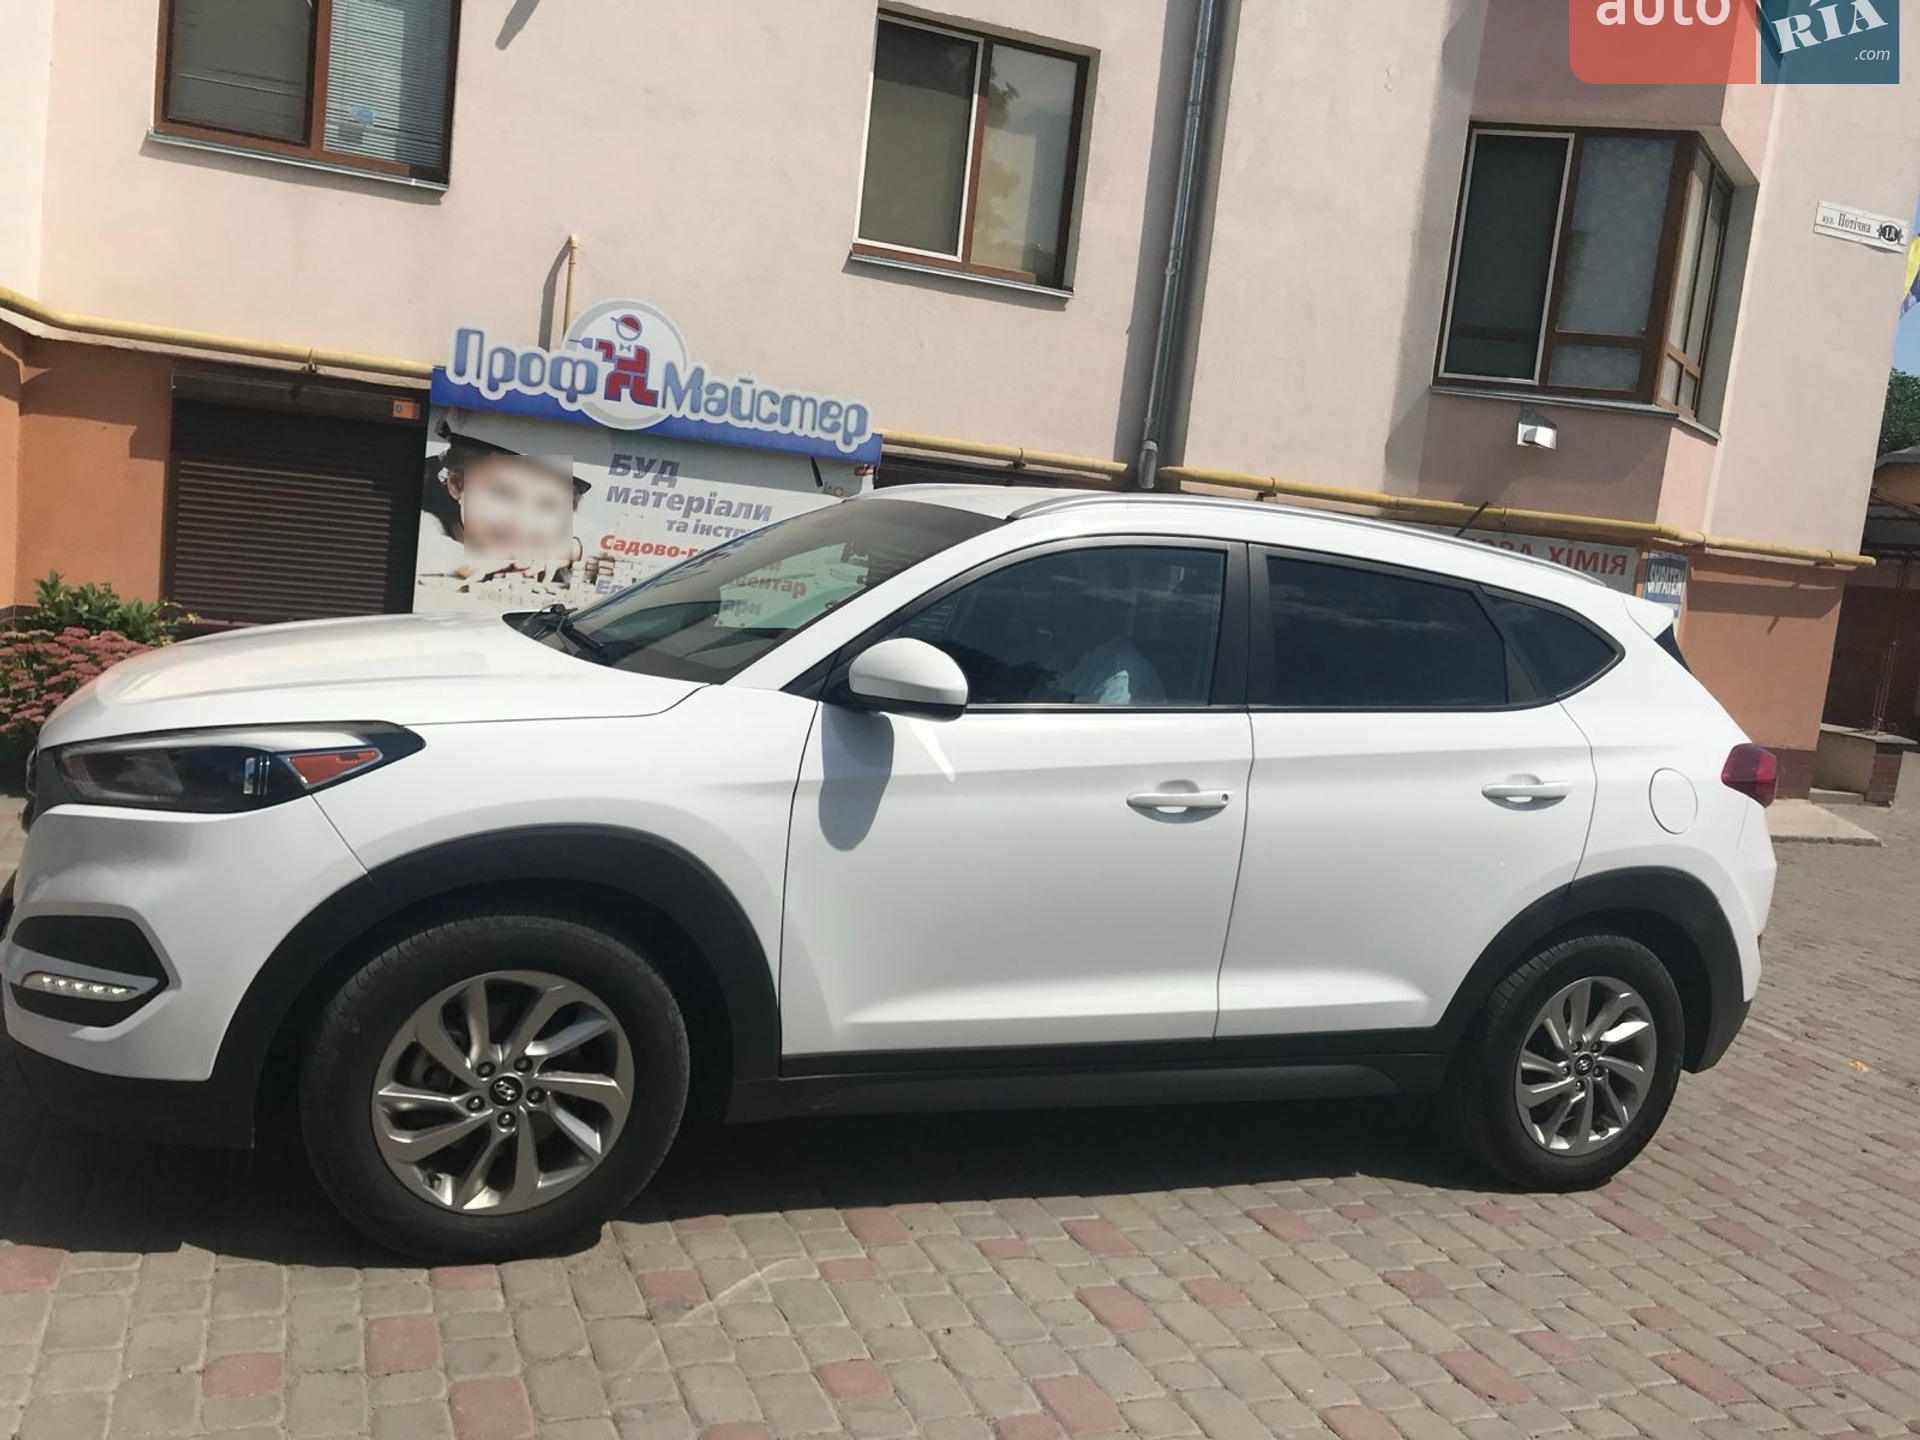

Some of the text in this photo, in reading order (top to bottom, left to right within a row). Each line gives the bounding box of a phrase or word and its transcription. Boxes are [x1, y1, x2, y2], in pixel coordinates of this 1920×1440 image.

[453, 327, 869, 447] Проф Майстер
[607, 452, 681, 489] БУД
[666, 519, 689, 534] та
